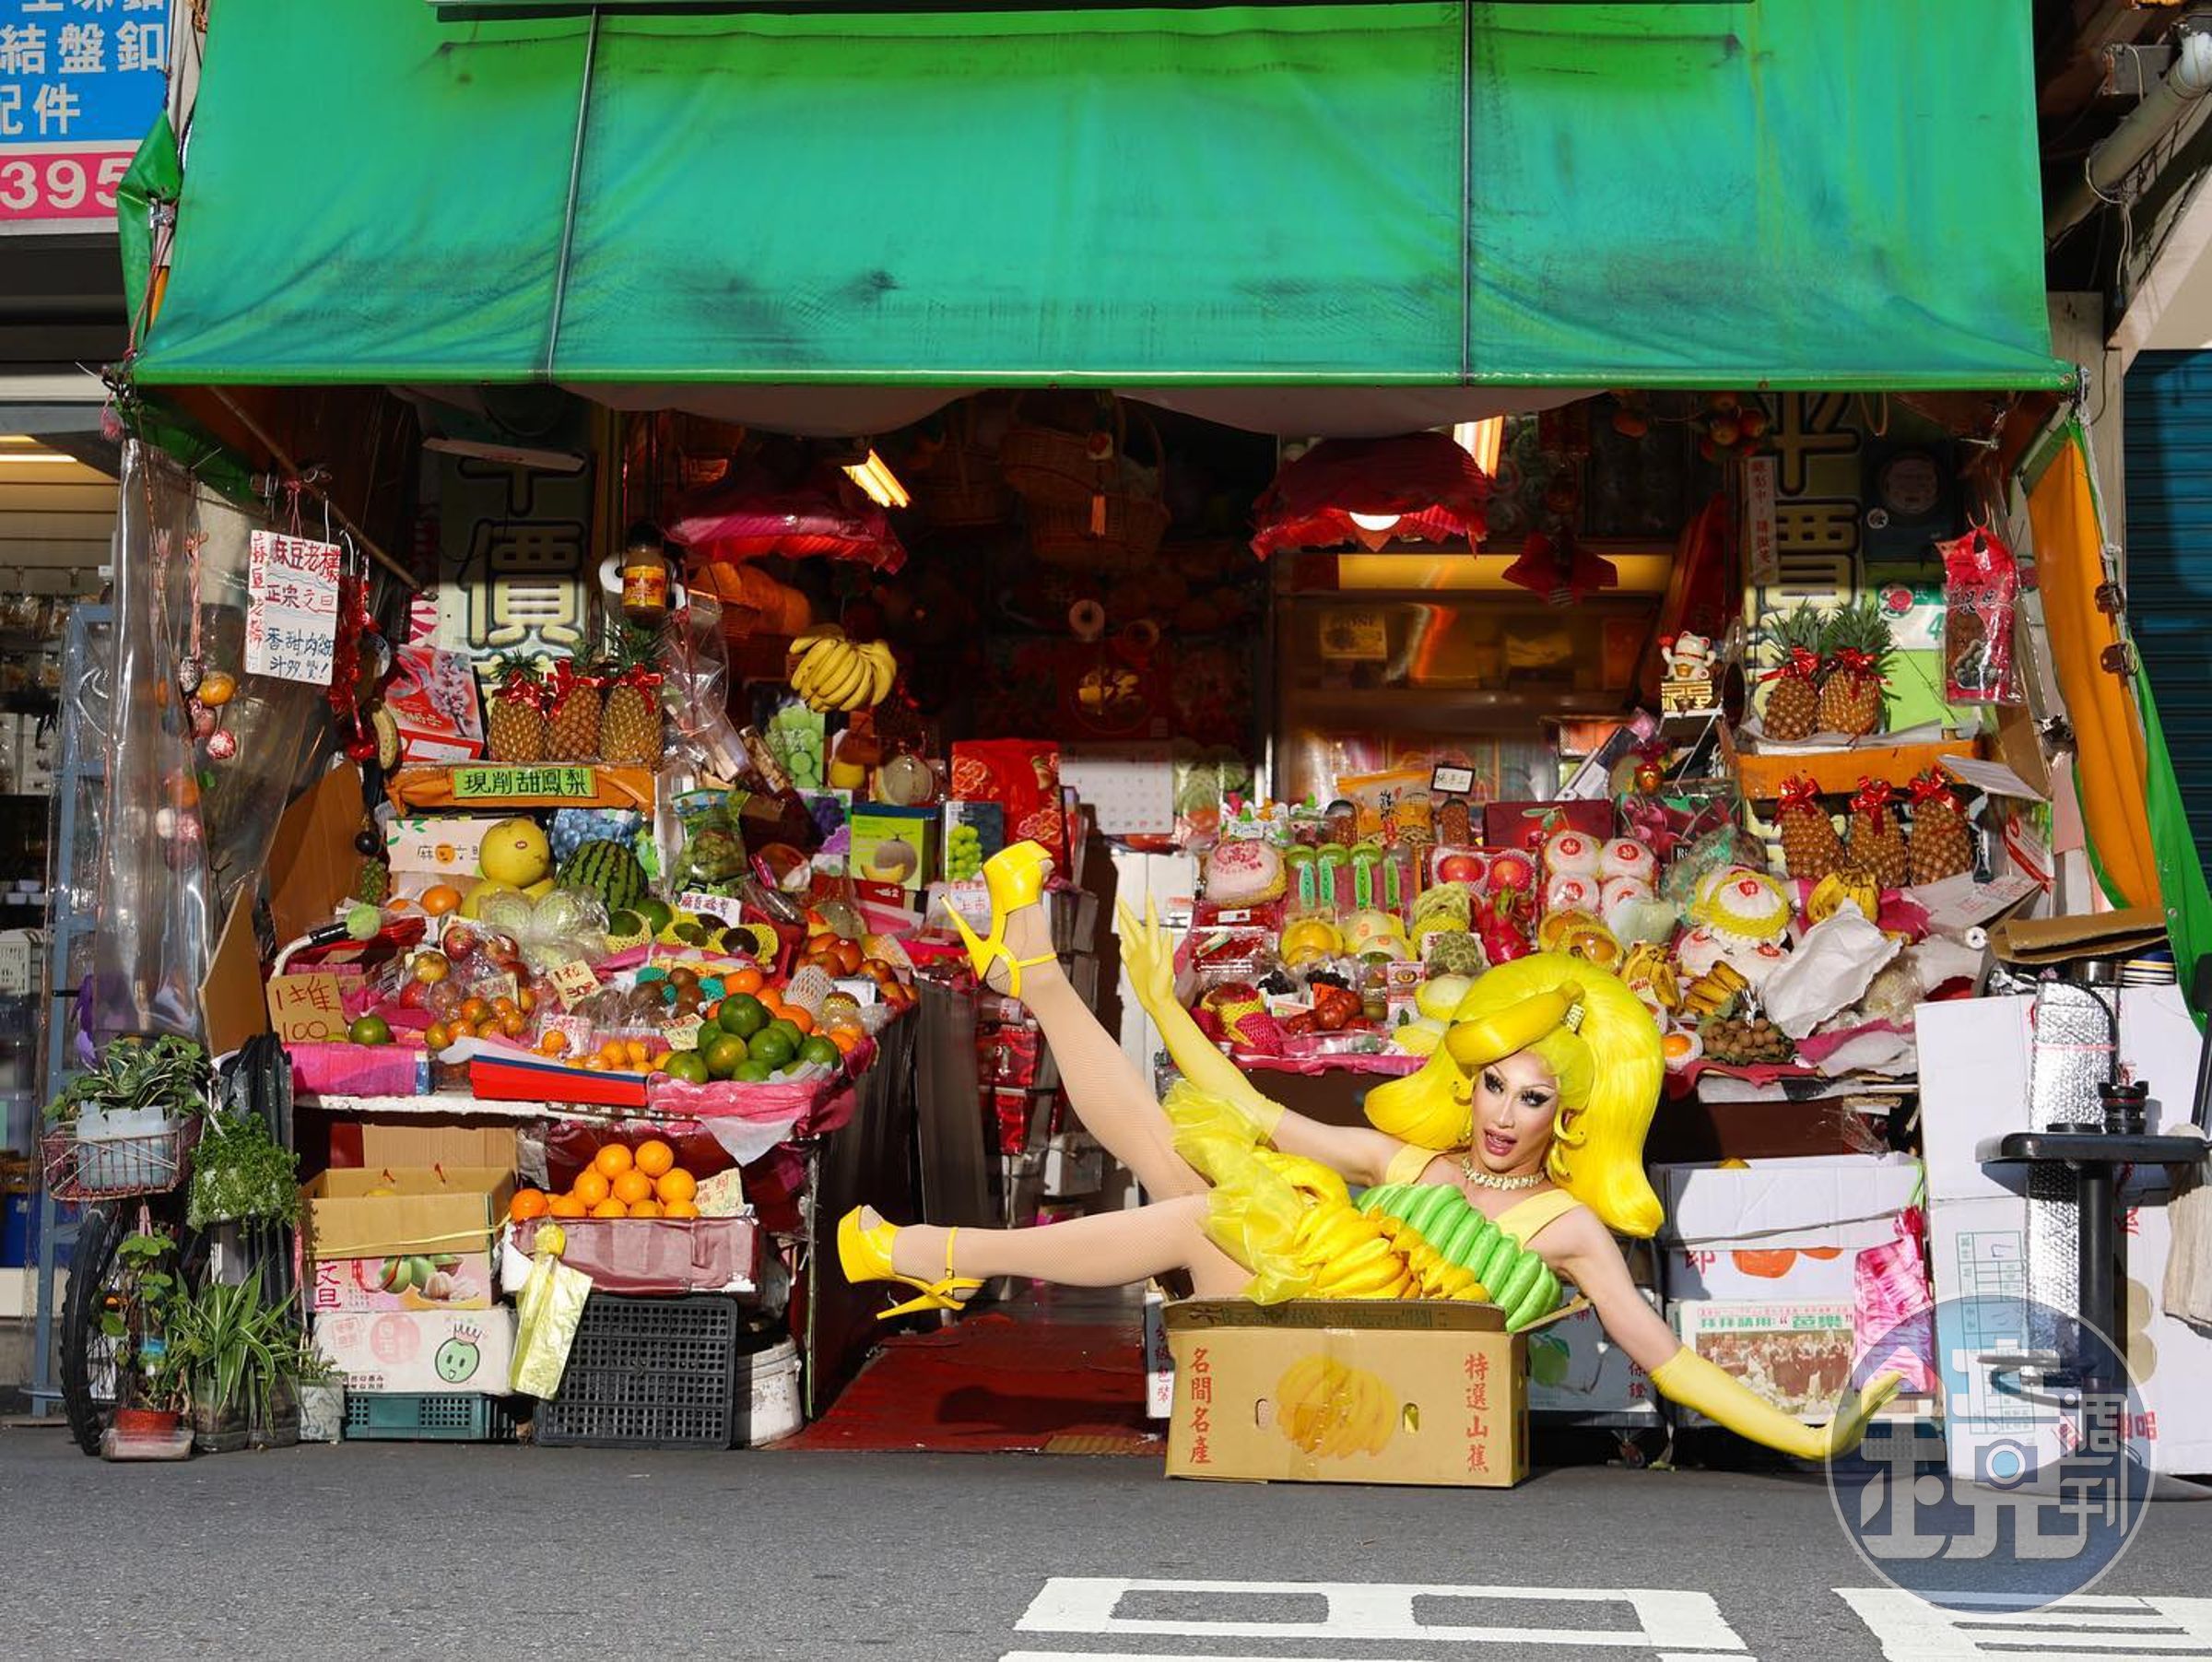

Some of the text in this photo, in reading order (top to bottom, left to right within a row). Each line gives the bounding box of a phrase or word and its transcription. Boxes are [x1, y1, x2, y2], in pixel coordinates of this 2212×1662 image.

[0, 20, 165, 75] 結盤釦
[0, 158, 135, 210] 395
[265, 583, 339, 614] 正宗文旦
[464, 769, 587, 796] 現削甜鳳梨
[1189, 1348, 1213, 1464] 名間名產
[1465, 1351, 1489, 1473] 特選山蕉
